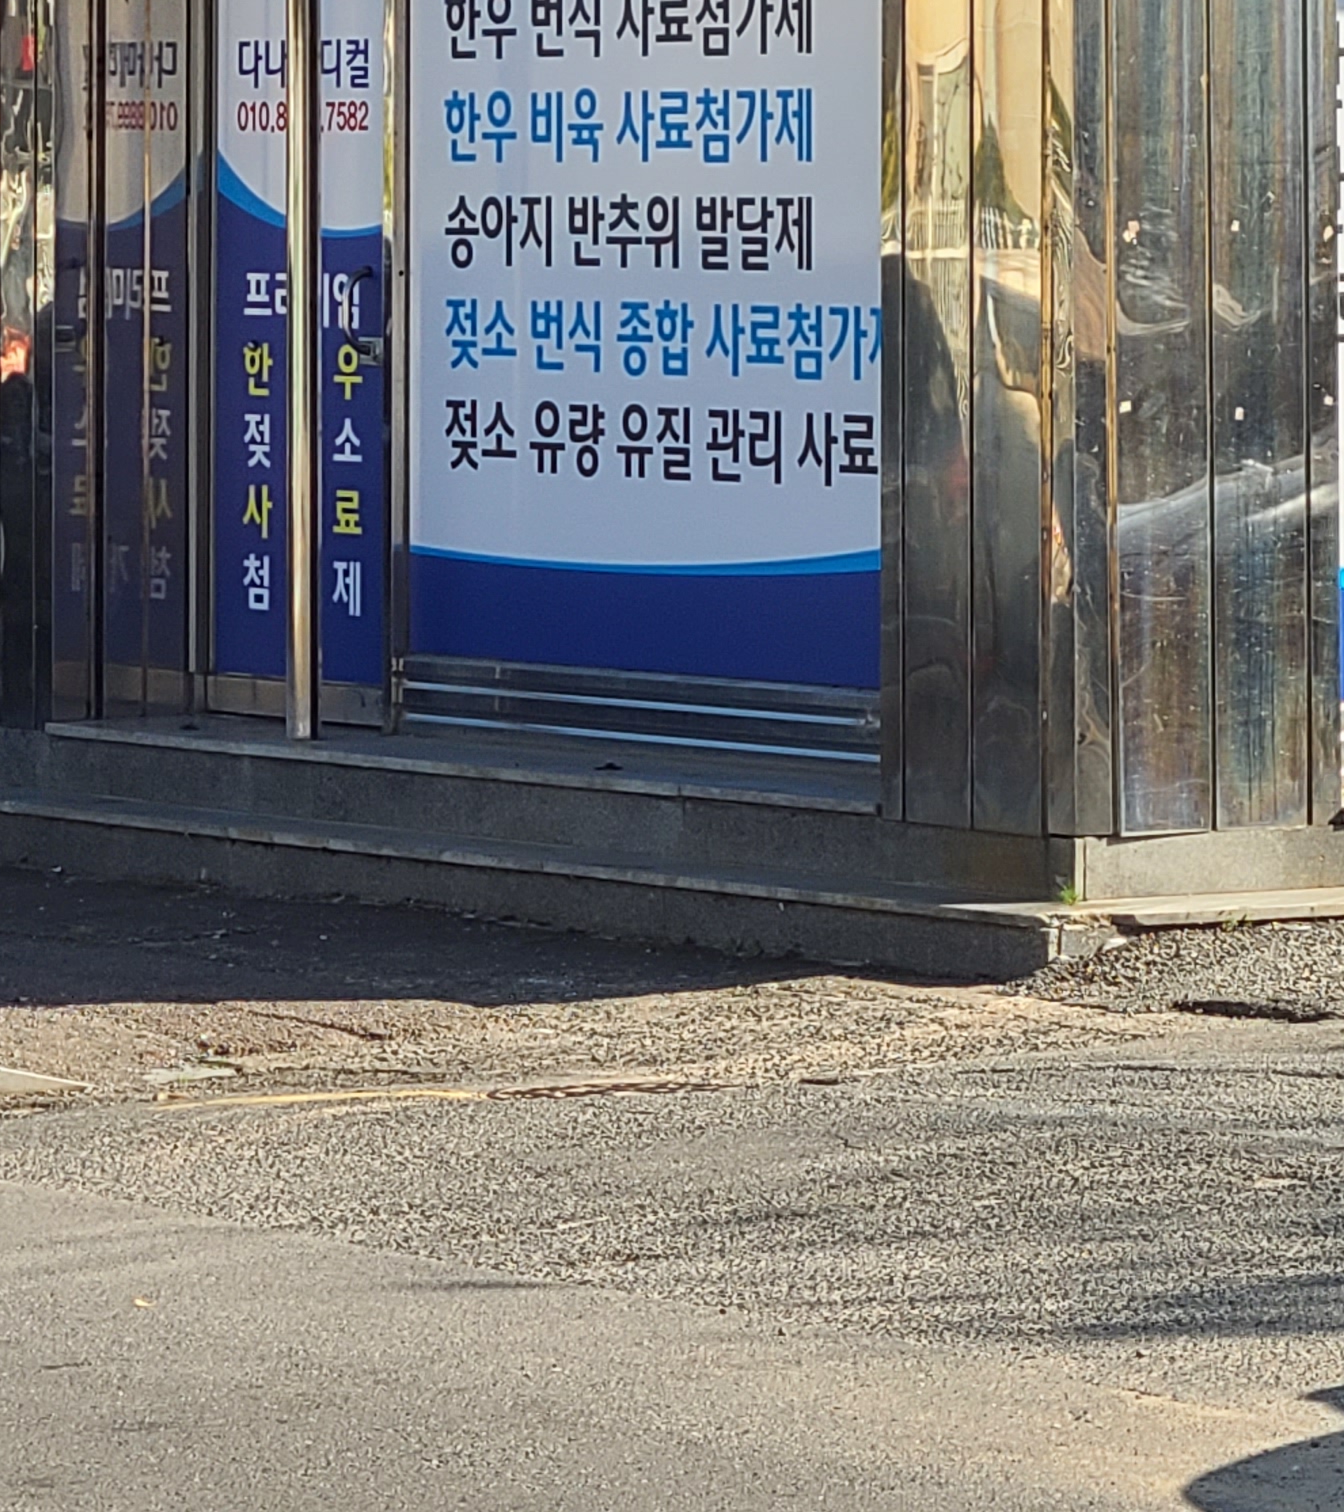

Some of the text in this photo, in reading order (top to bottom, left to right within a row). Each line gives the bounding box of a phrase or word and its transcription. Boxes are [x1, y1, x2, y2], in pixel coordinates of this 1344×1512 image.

[238, 38, 369, 89] 다나디컬
[237, 101, 369, 133] 010.8.7582
[444, 88, 812, 163] 한우 비육 사료첨가제
[445, 193, 812, 271] 송아지 반추위 발달제
[445, 298, 517, 370] 젖소
[531, 299, 601, 373] 번식
[616, 300, 694, 377] 종합
[445, 398, 878, 487] 젖소 유량 유질 관리 사료
